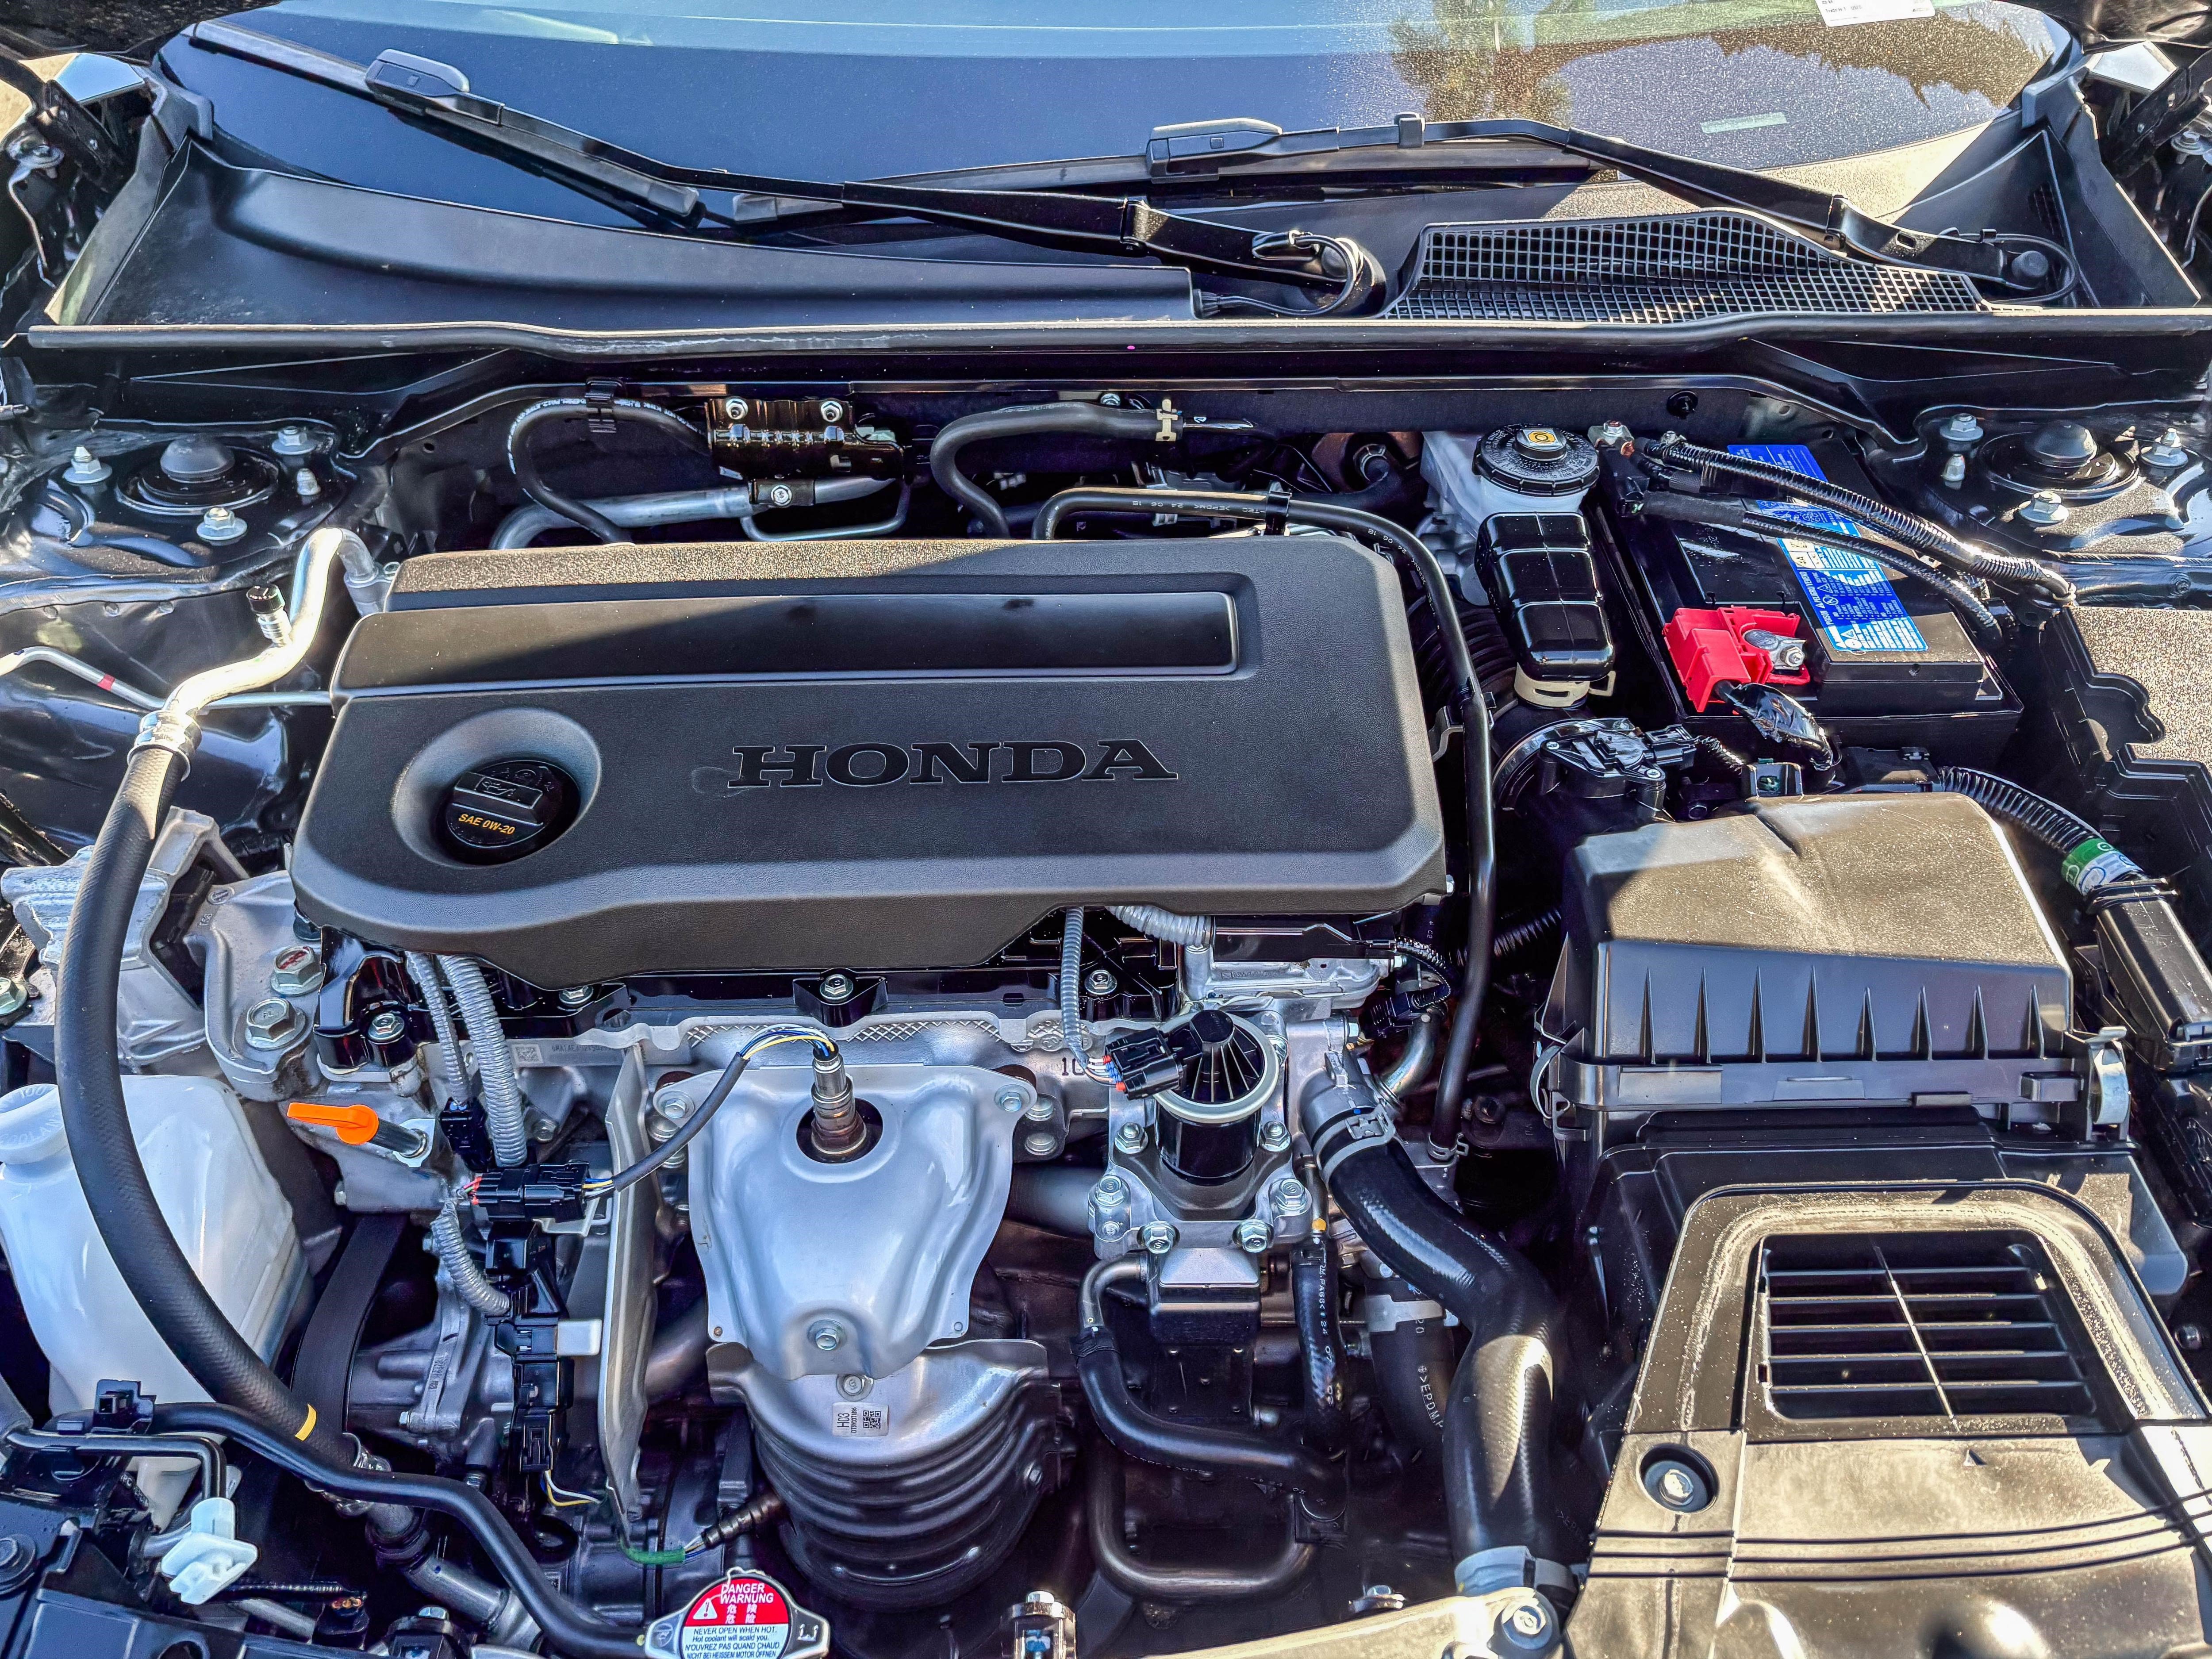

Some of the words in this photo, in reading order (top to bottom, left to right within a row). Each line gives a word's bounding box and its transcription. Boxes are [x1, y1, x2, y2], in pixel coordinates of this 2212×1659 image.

[1382, 535, 1393, 544] 06
[727, 739, 1179, 787] HONDA
[459, 814, 484, 826] SAE
[482, 820, 515, 834] 0W-20
[837, 1413, 850, 1428] H03
[722, 1583, 765, 1593] DANGER
[720, 1593, 774, 1604] WARNUNG
[733, 1642, 756, 1651] QUAND
